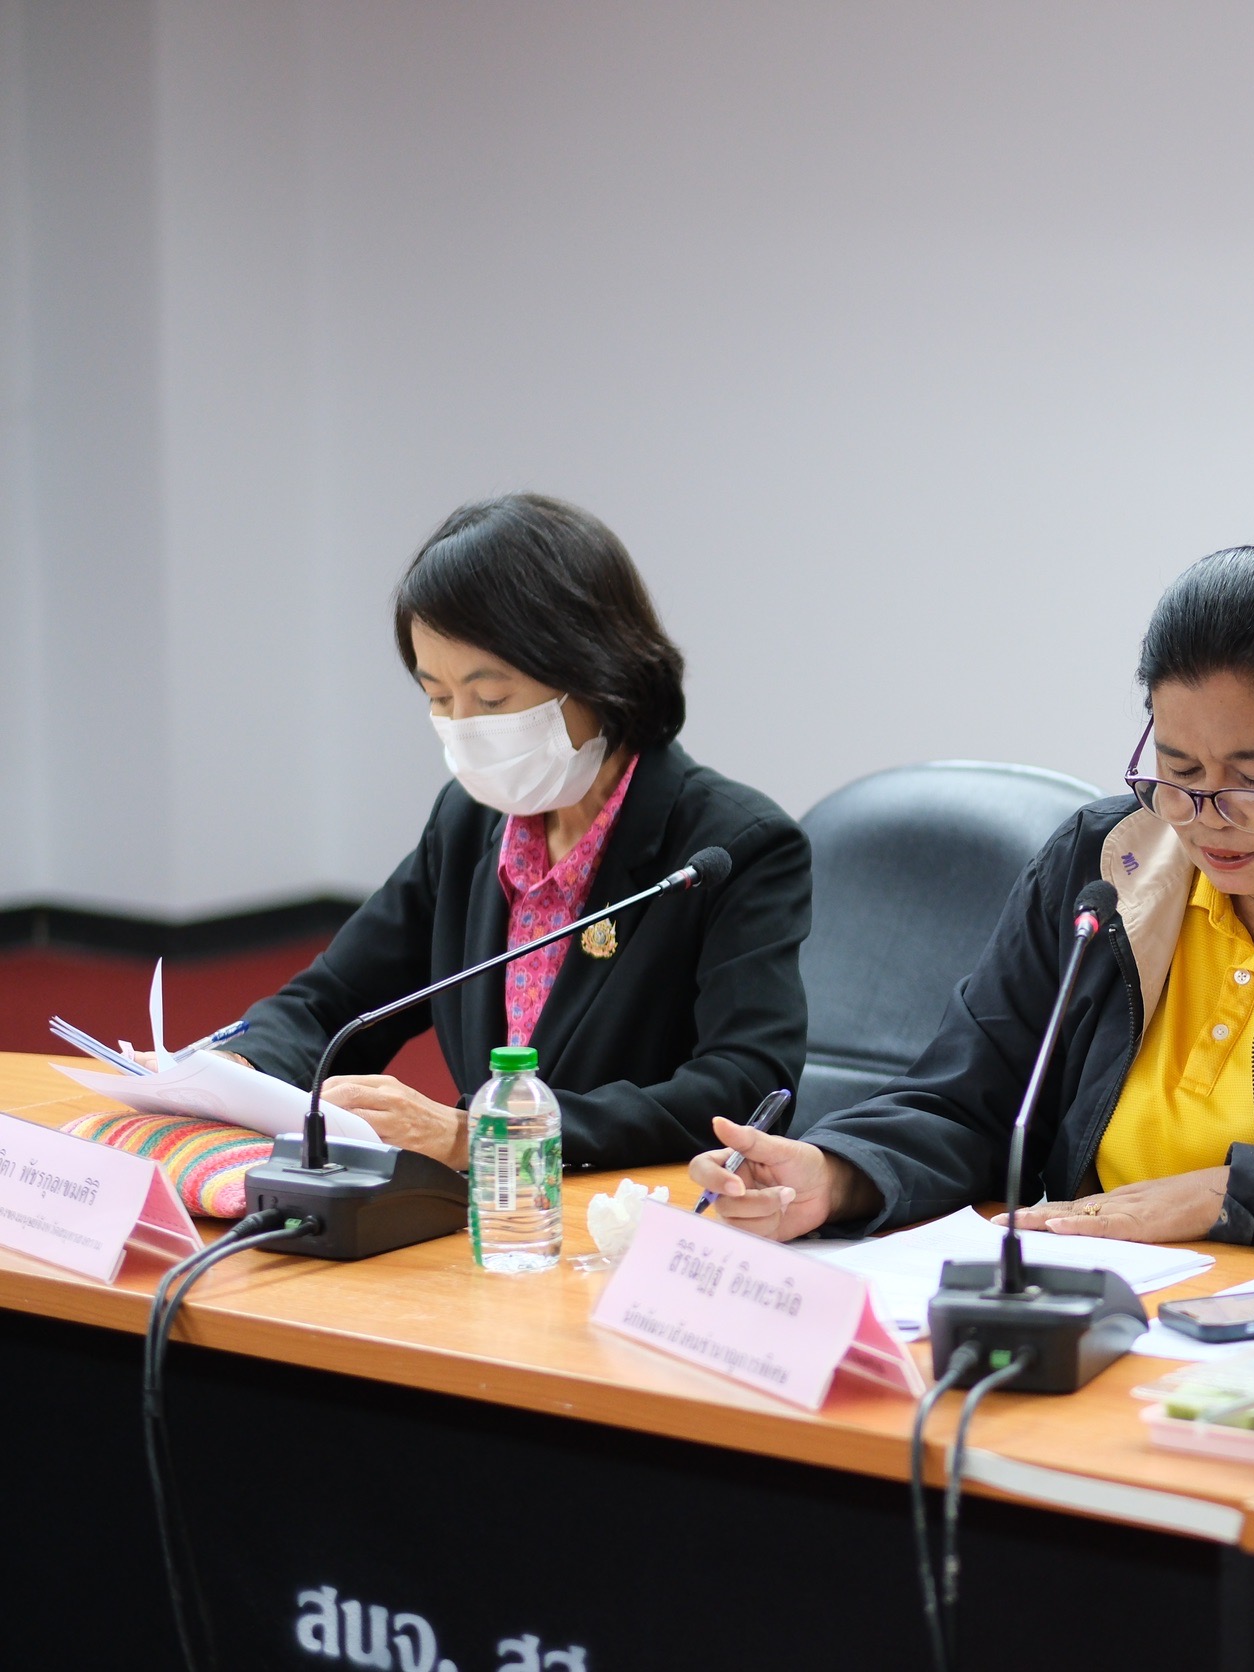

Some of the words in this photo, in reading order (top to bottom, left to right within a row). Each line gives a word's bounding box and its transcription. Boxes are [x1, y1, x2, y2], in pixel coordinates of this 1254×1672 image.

[20, 1158, 101, 1206] พัชรกุลเขมศิริ
